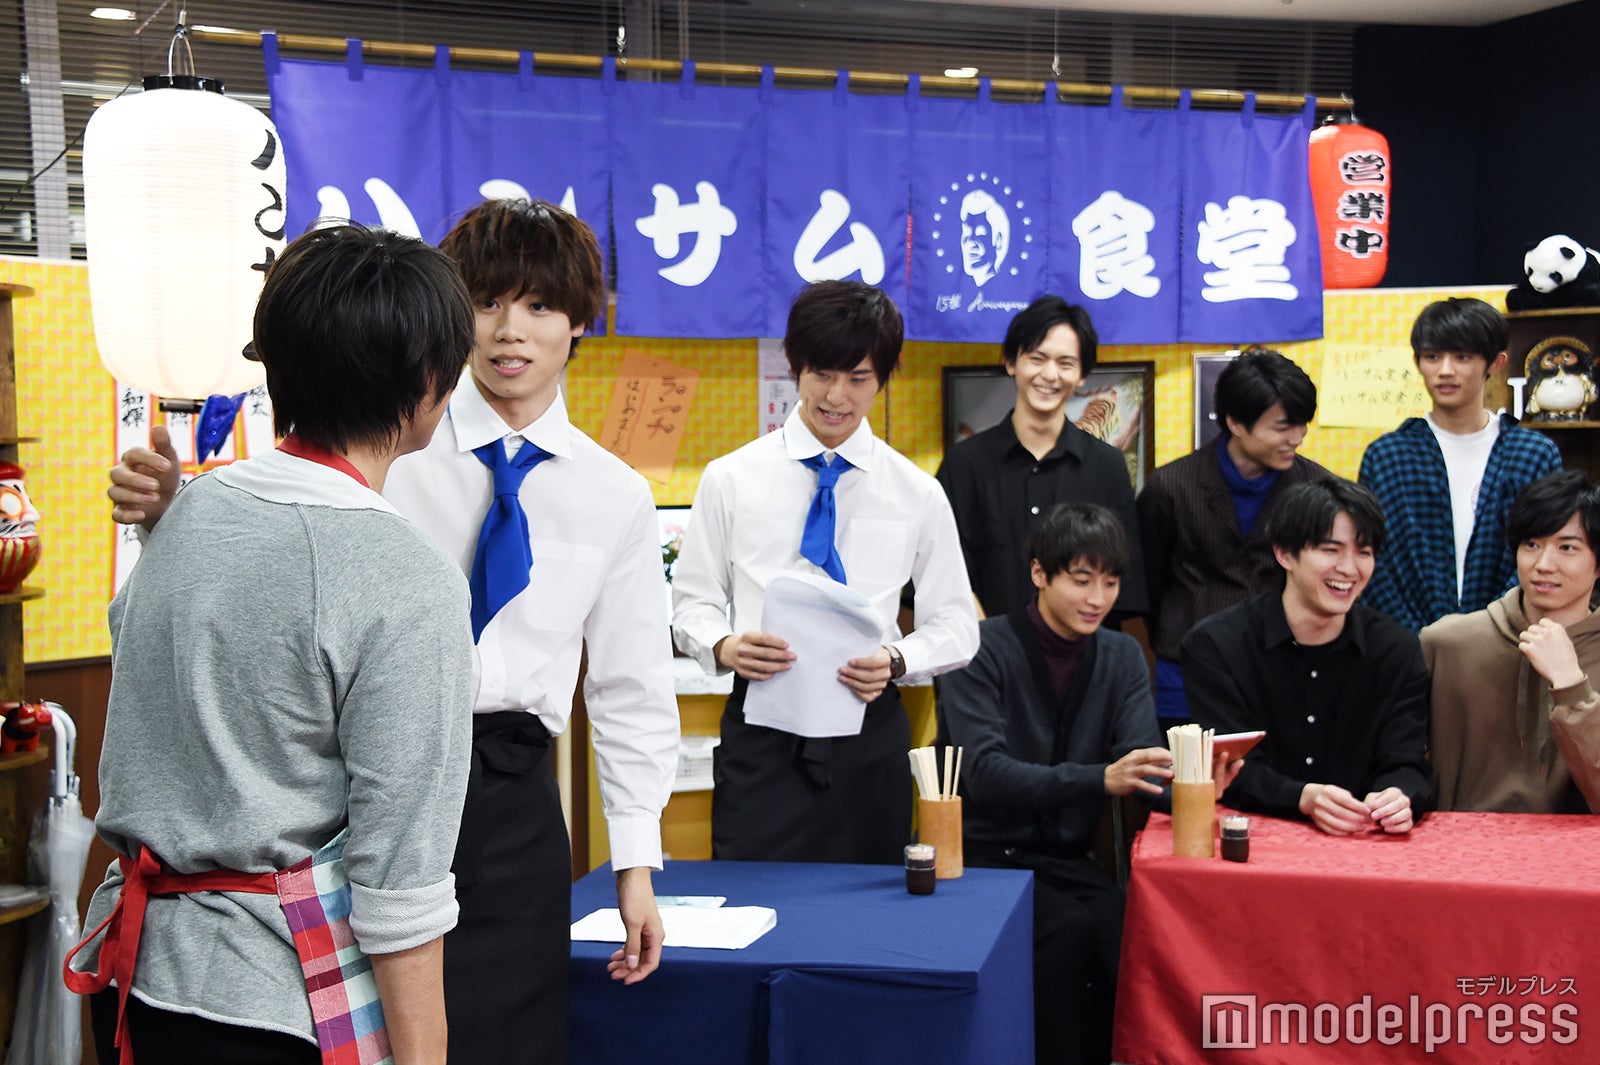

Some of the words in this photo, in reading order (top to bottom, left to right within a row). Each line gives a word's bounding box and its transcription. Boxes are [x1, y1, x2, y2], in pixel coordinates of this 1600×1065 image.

[1072, 190, 1298, 303] 食堂
[1338, 152, 1386, 256] 営業中
